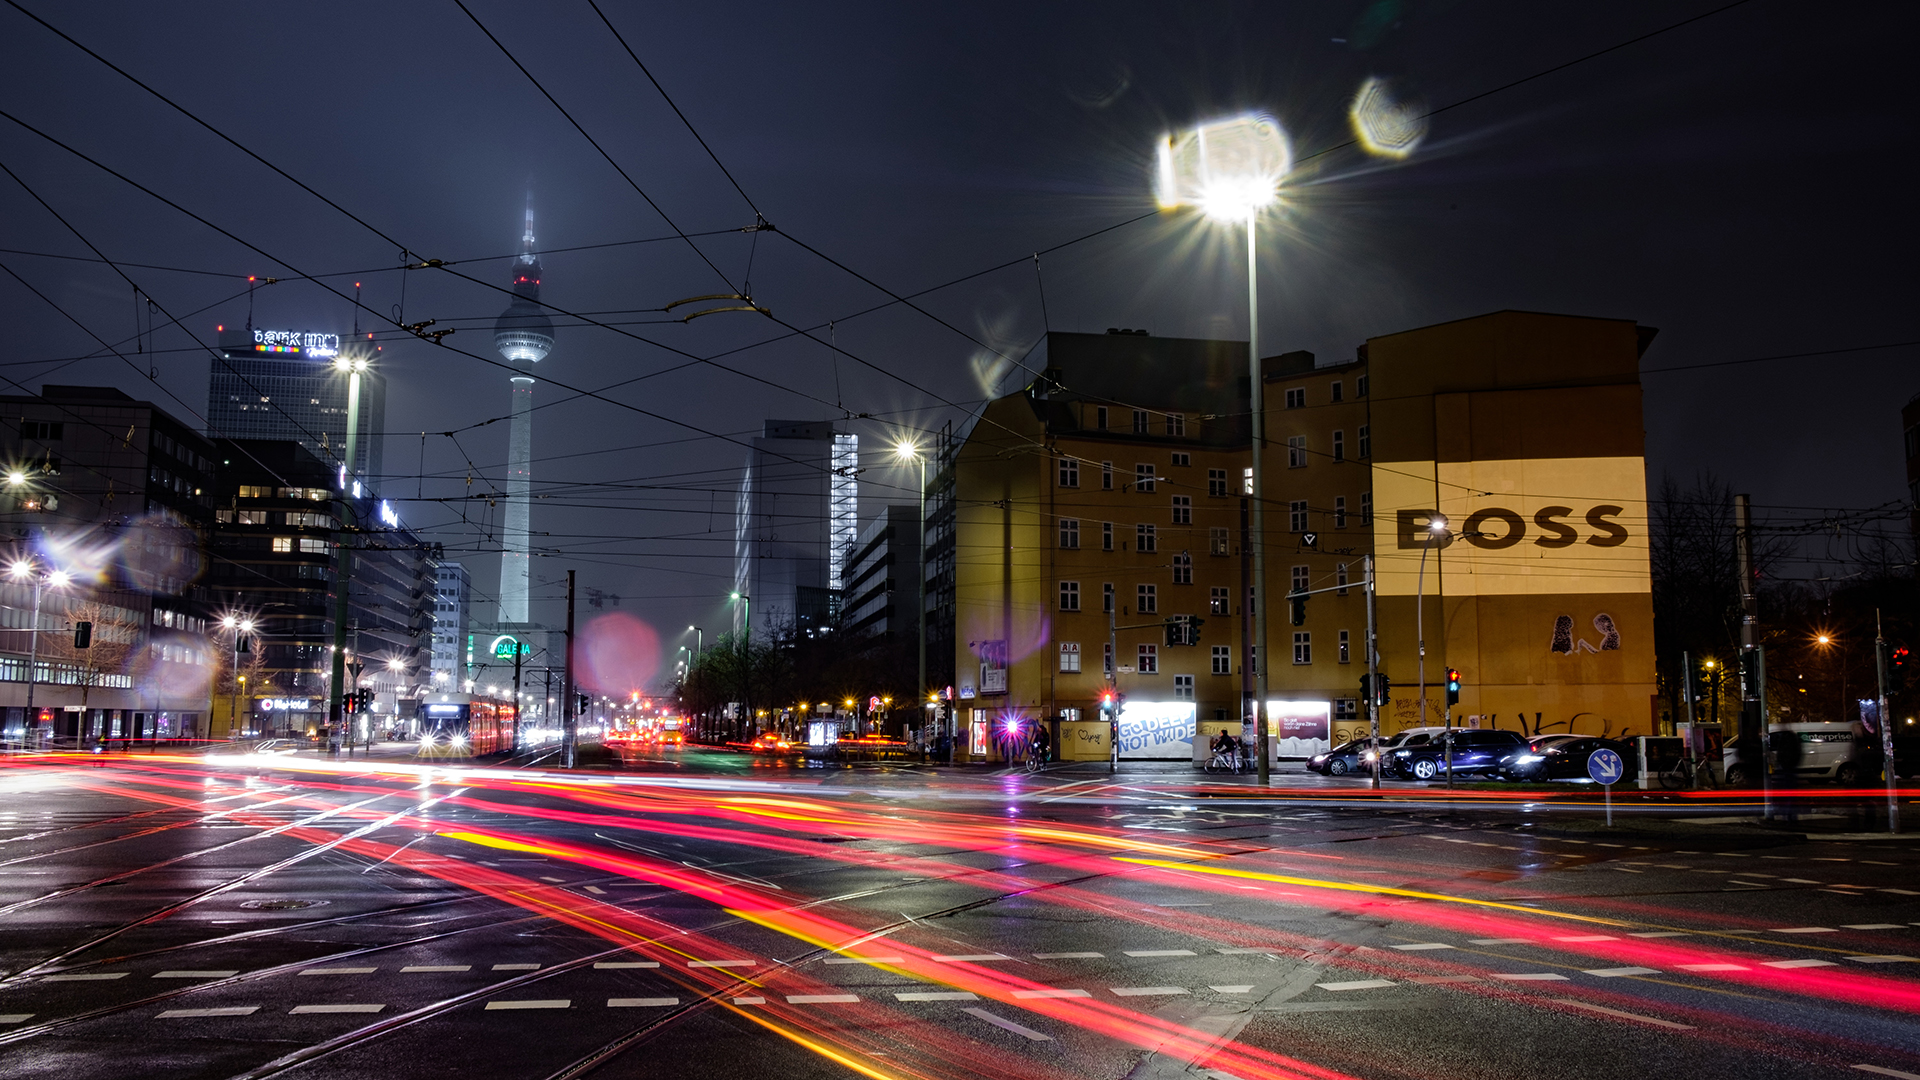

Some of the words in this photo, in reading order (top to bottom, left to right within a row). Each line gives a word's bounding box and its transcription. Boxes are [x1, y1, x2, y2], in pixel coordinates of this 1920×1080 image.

[1397, 505, 1628, 550] BOSS
[497, 643, 530, 654] GALEIA
[1119, 721, 1143, 737] GO
[1146, 712, 1191, 732] DEEP
[1801, 733, 1853, 741] enterprise
[1119, 733, 1150, 753] NOT
[1153, 724, 1196, 745] WIDE
